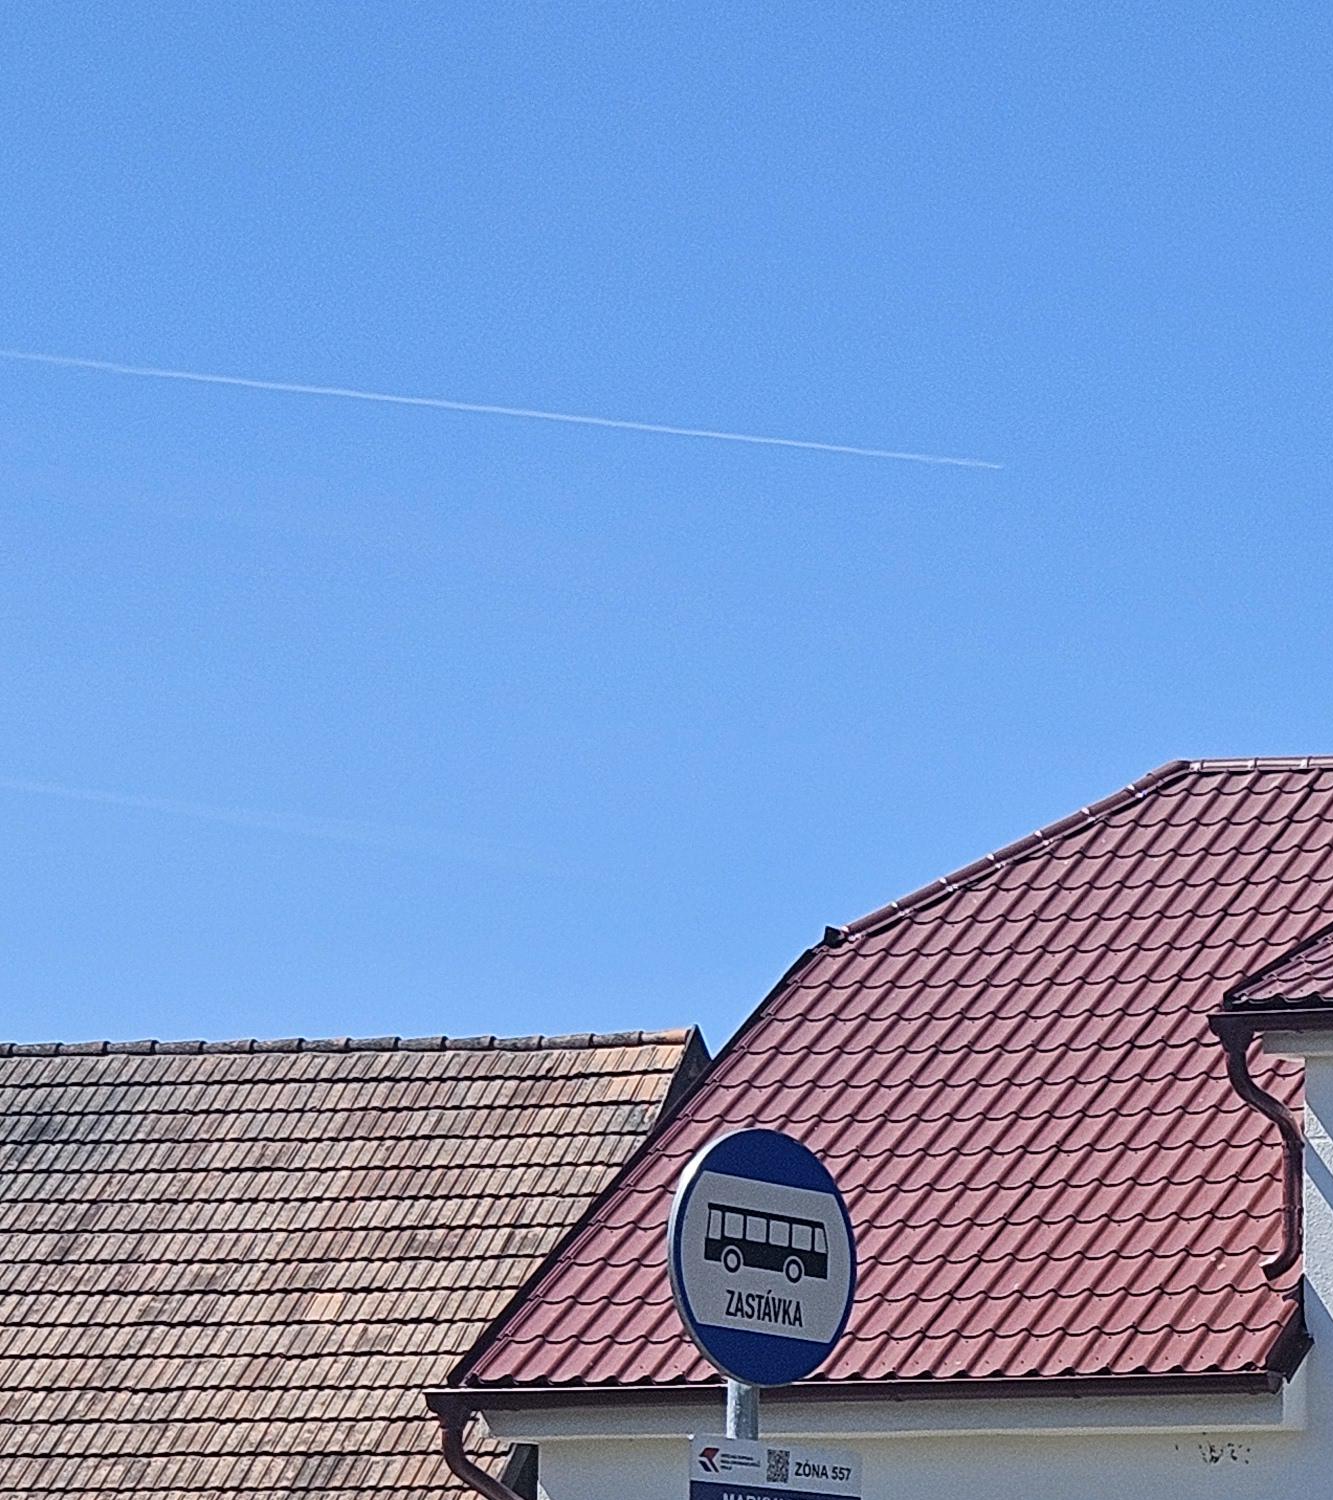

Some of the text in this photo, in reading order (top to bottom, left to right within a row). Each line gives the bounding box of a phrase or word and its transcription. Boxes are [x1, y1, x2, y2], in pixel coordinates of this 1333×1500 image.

[725, 1289, 803, 1328] ZASTÁVKA
[795, 1459, 852, 1481] ZÓNA 557
